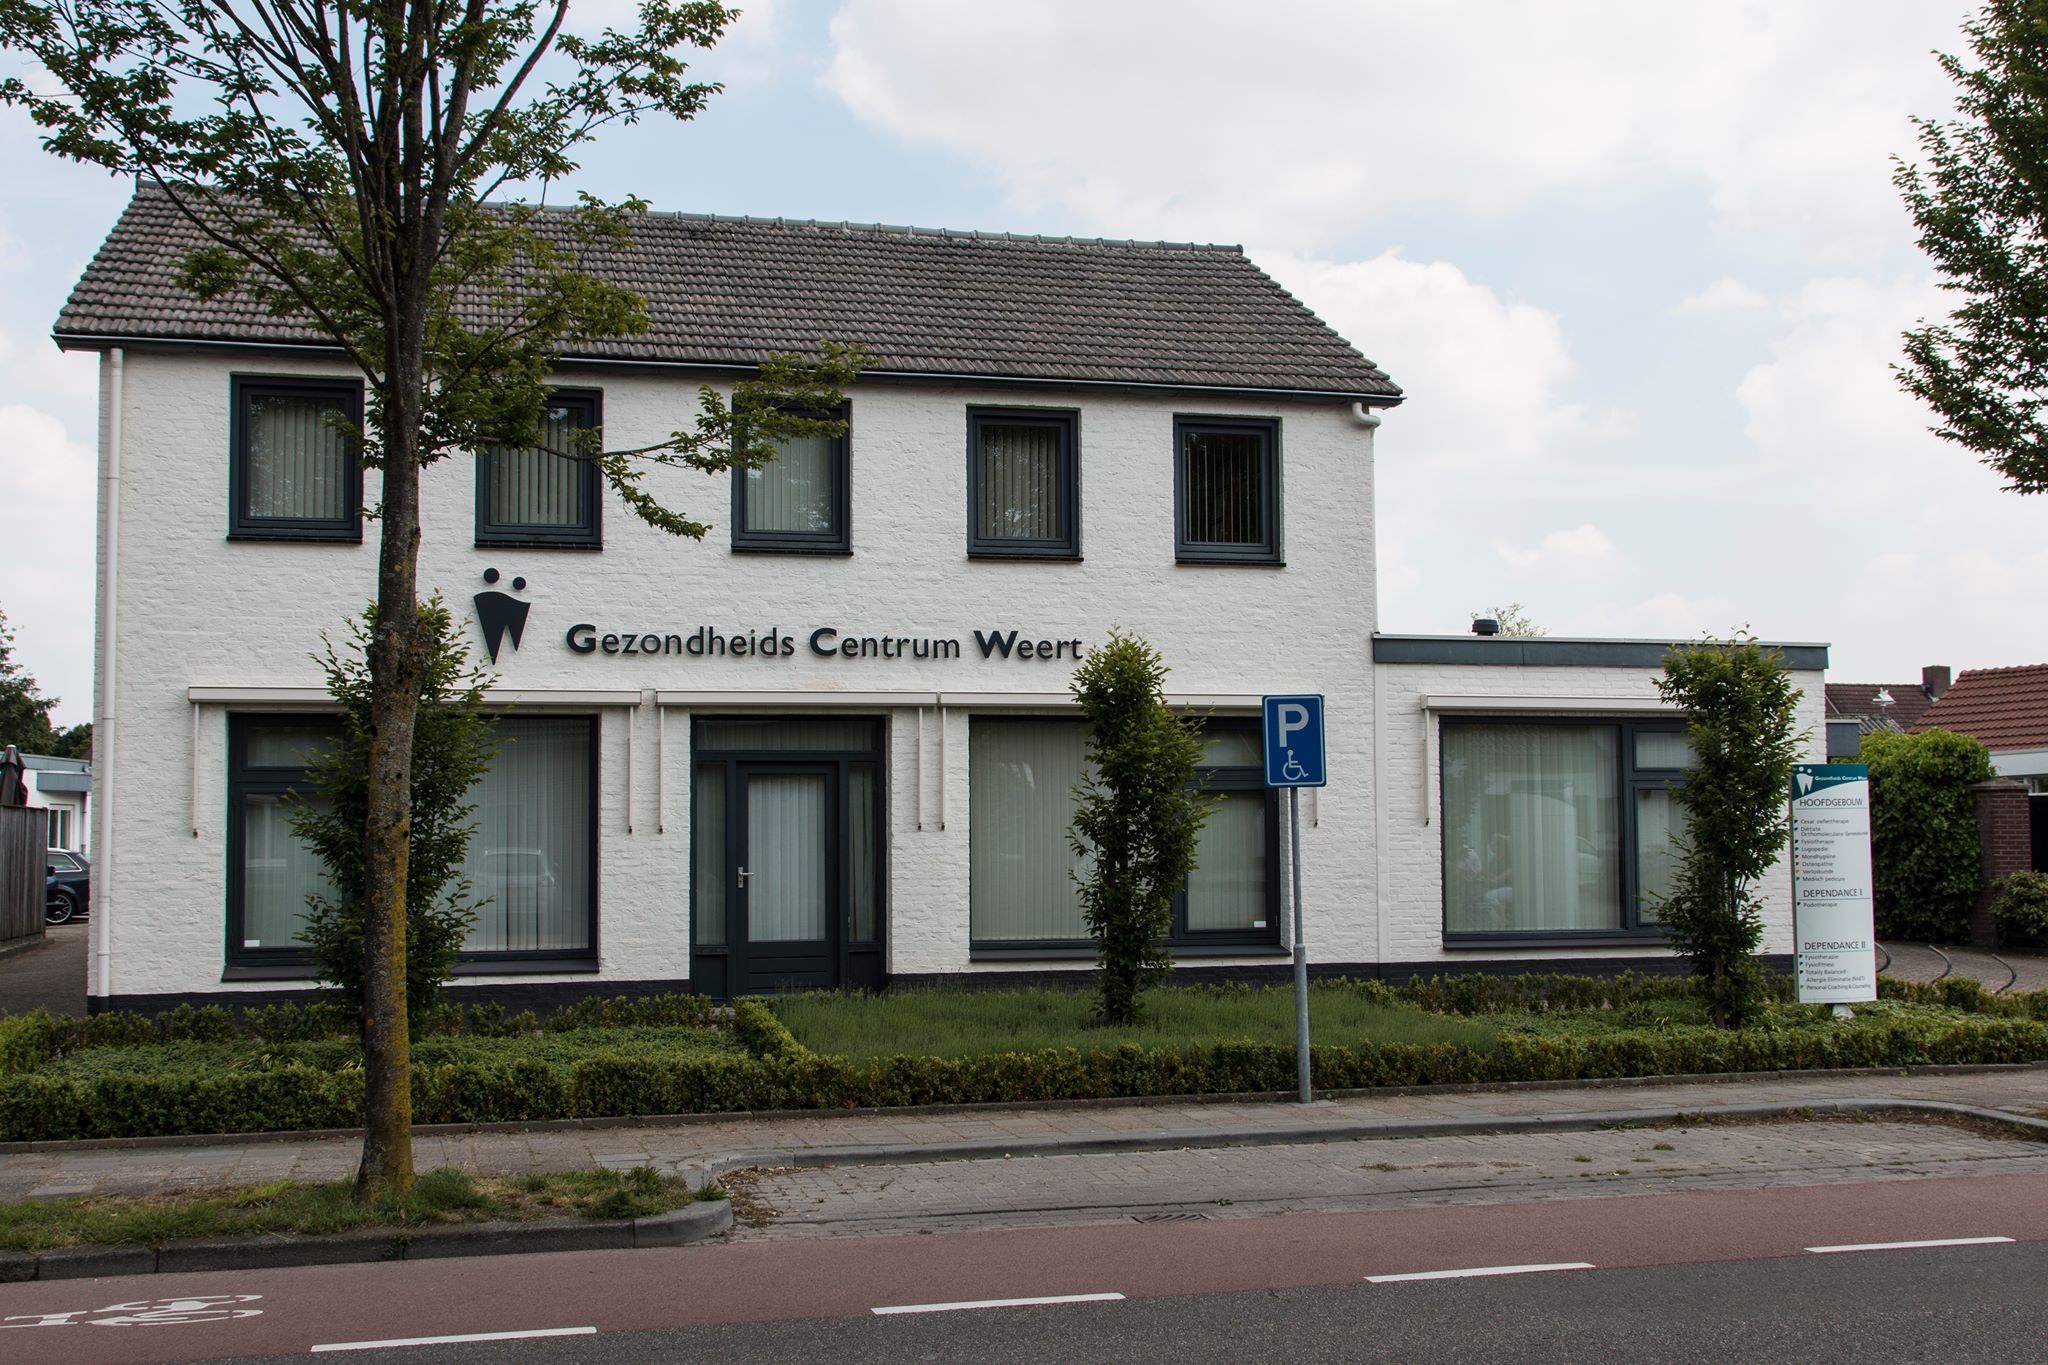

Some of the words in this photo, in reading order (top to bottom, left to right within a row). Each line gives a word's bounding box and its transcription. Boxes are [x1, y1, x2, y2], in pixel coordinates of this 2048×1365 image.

[567, 623, 795, 657] Gezondheids
[810, 627, 960, 659] Centrum
[974, 630, 1082, 660] Weert
[1278, 703, 1309, 747] P
[1799, 798, 1863, 807] HOOFDGEBOUW
[1803, 888, 1858, 898] DEPENDANCE
[1804, 941, 1859, 951] DEPENDANCE
